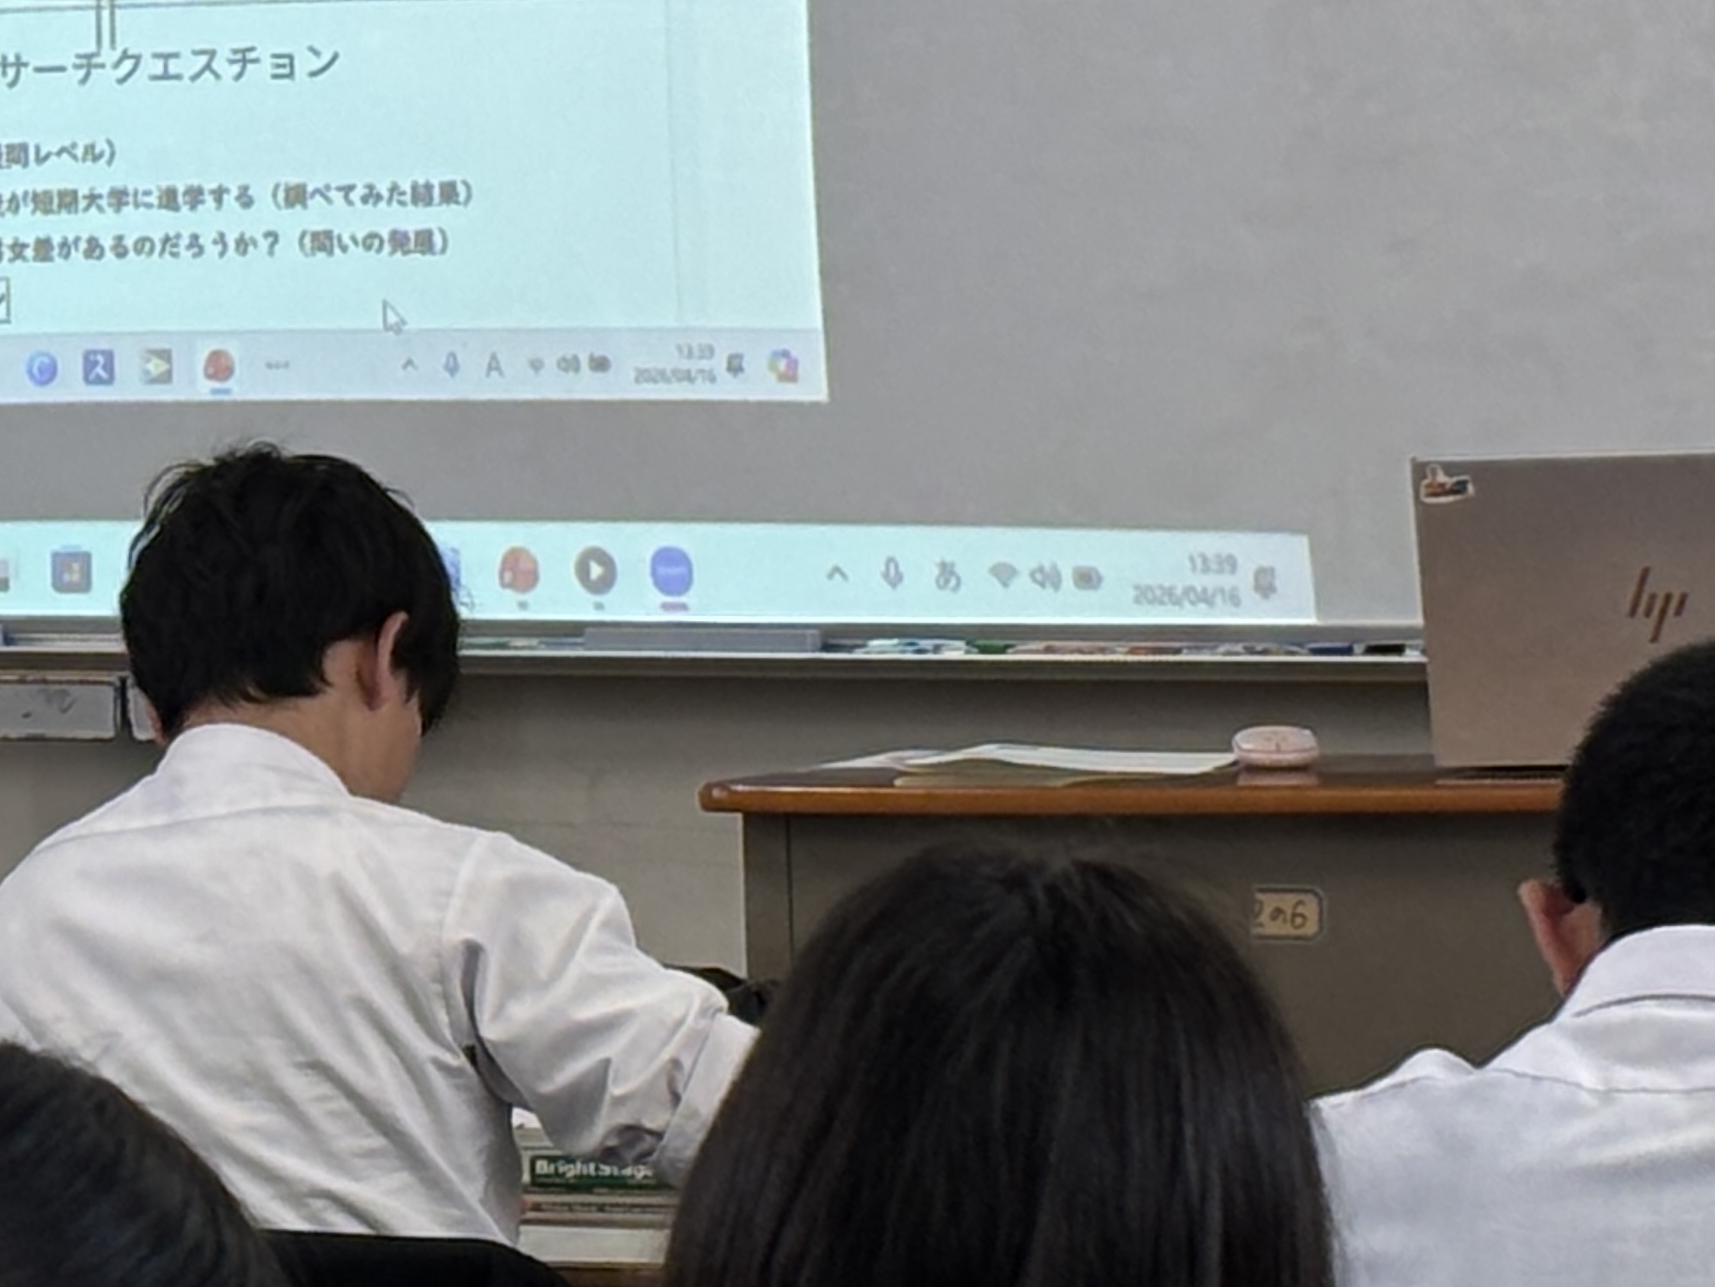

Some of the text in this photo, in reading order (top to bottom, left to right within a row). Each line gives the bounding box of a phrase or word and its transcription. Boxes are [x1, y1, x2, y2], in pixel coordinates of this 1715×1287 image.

[484, 351, 504, 378] A
[934, 559, 962, 593] あ
[1187, 552, 1237, 575] 13:39
[1132, 583, 1241, 608] 2026/04/16
[1627, 566, 1689, 644] hp
